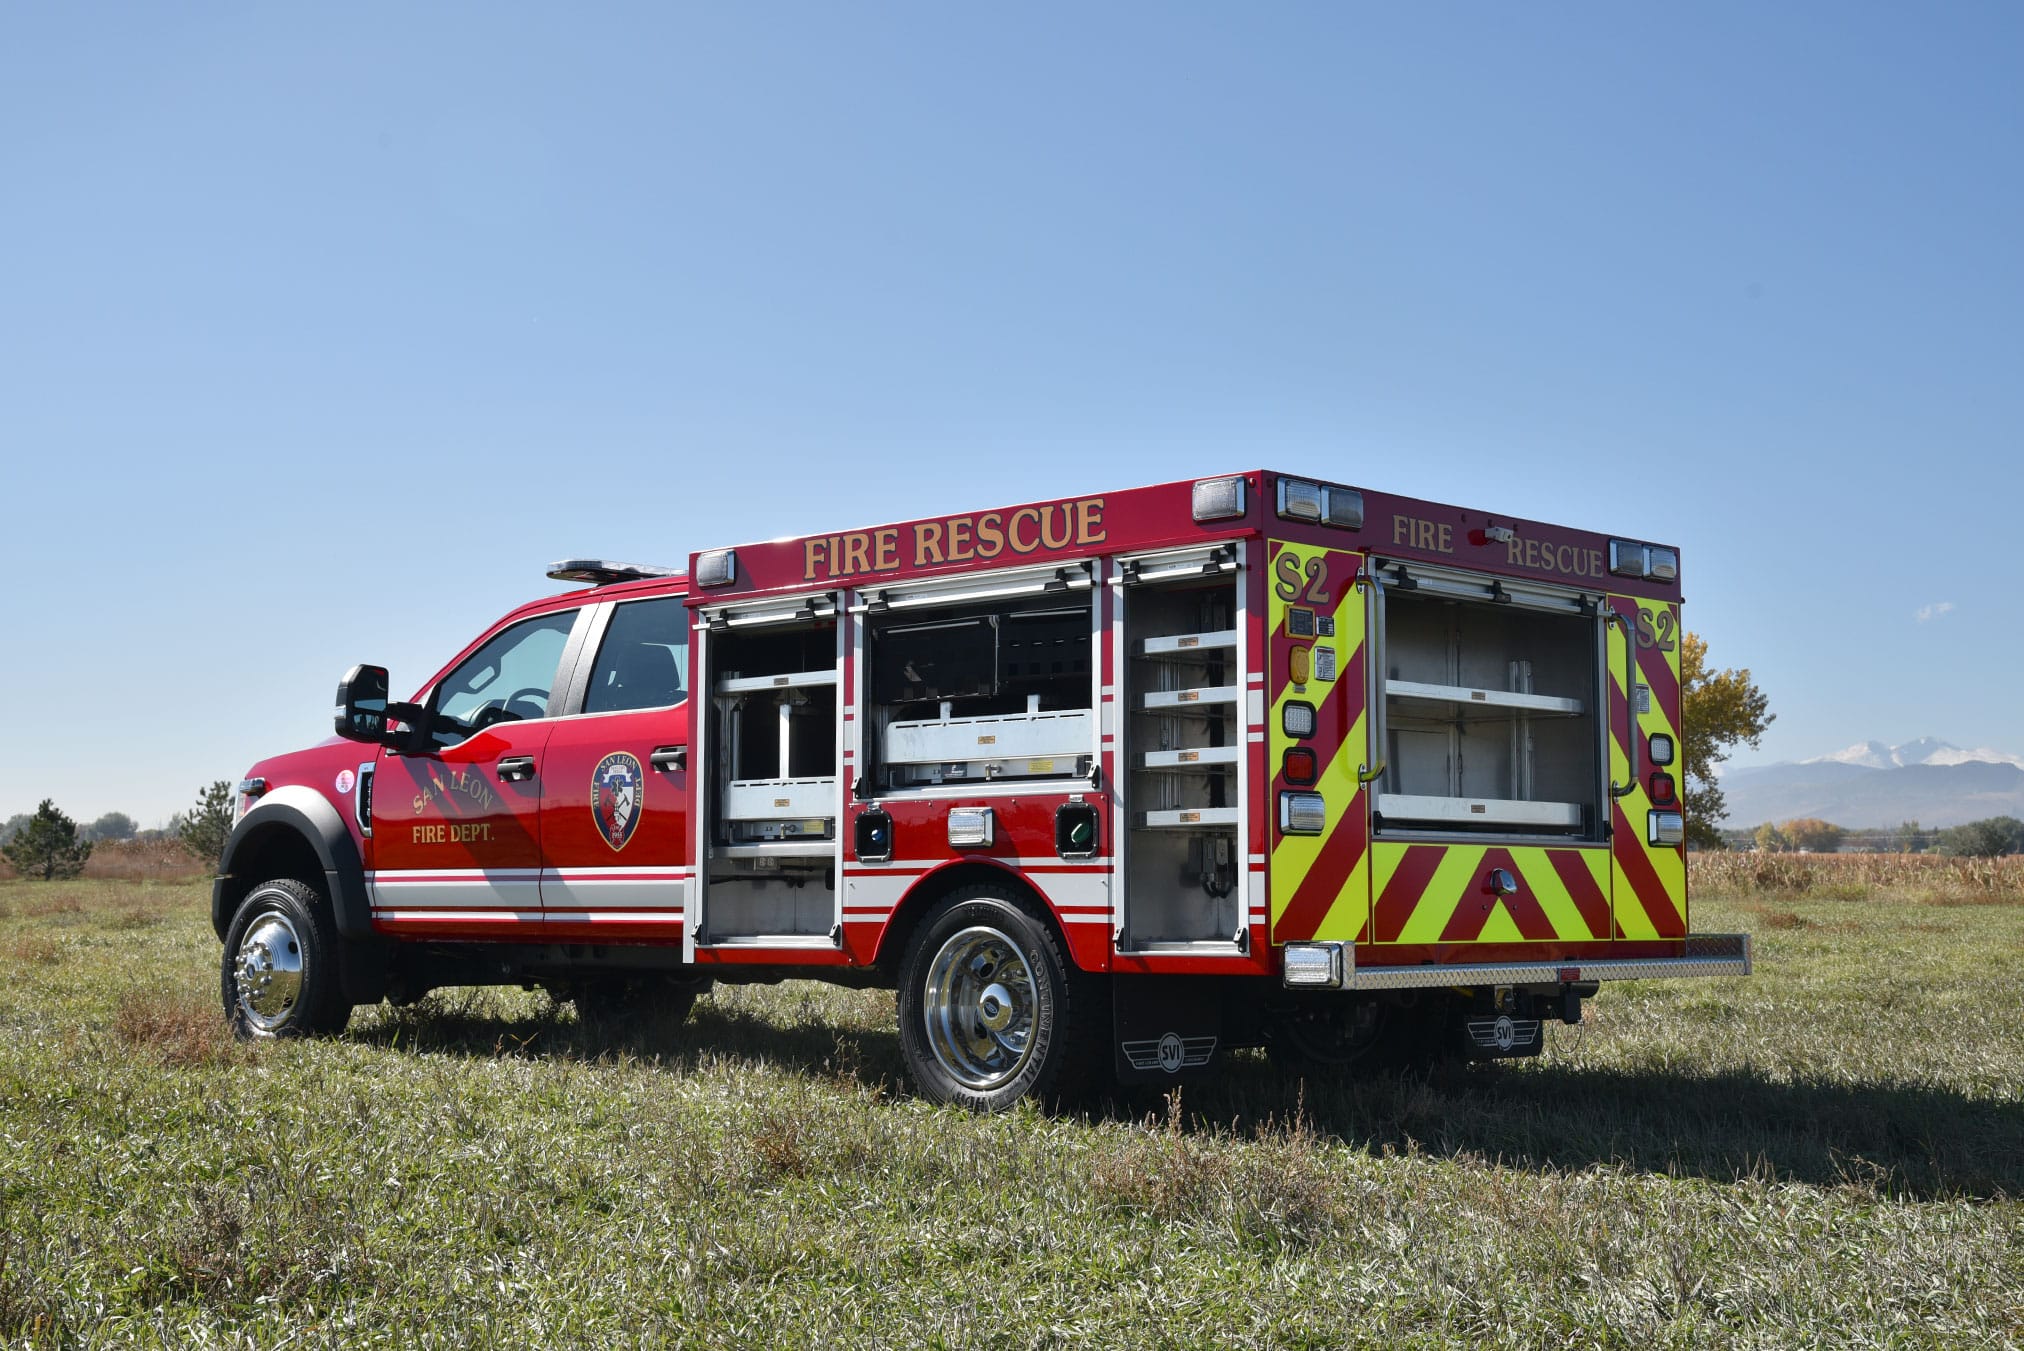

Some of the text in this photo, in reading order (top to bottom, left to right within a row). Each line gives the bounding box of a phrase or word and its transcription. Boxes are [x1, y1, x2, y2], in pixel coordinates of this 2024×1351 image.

[804, 498, 1106, 580] FIRE RESCUE
[1393, 515, 1604, 578] FIRE RESCUE
[1275, 551, 1330, 604] S2
[1636, 607, 1676, 652] S2
[600, 757, 615, 772] SAN
[616, 755, 637, 771] LEON
[413, 770, 494, 815] SAN LEON
[412, 823, 495, 844] FIRE DEPT.
[1020, 948, 1051, 1085] CONTINENTAL
[1497, 1026, 1511, 1040] SVI
[1162, 1044, 1180, 1061] SVI
